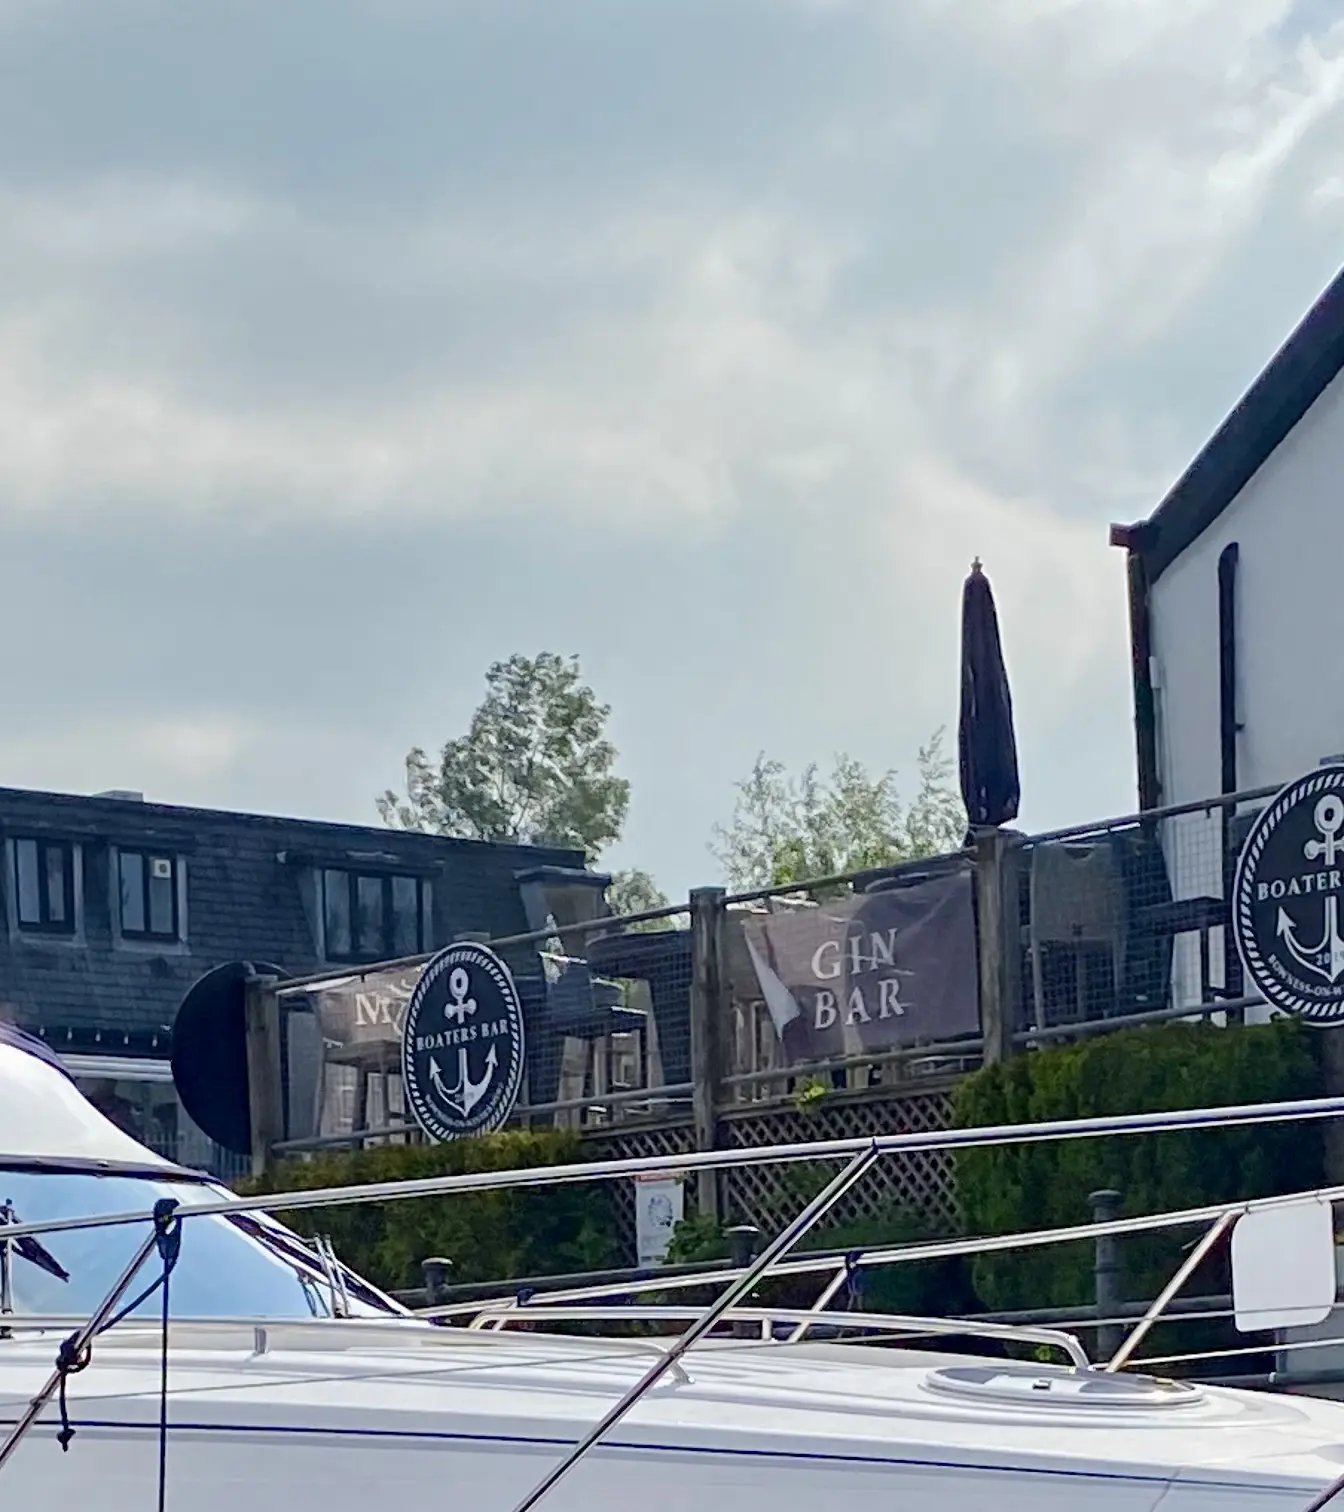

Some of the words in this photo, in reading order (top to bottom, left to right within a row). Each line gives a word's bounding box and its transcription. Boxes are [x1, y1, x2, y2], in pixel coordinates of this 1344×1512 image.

[811, 928, 897, 980] GIN
[814, 979, 904, 1029] BAR
[417, 1025, 478, 1050] BOATERS
[481, 1019, 508, 1036] BAR
